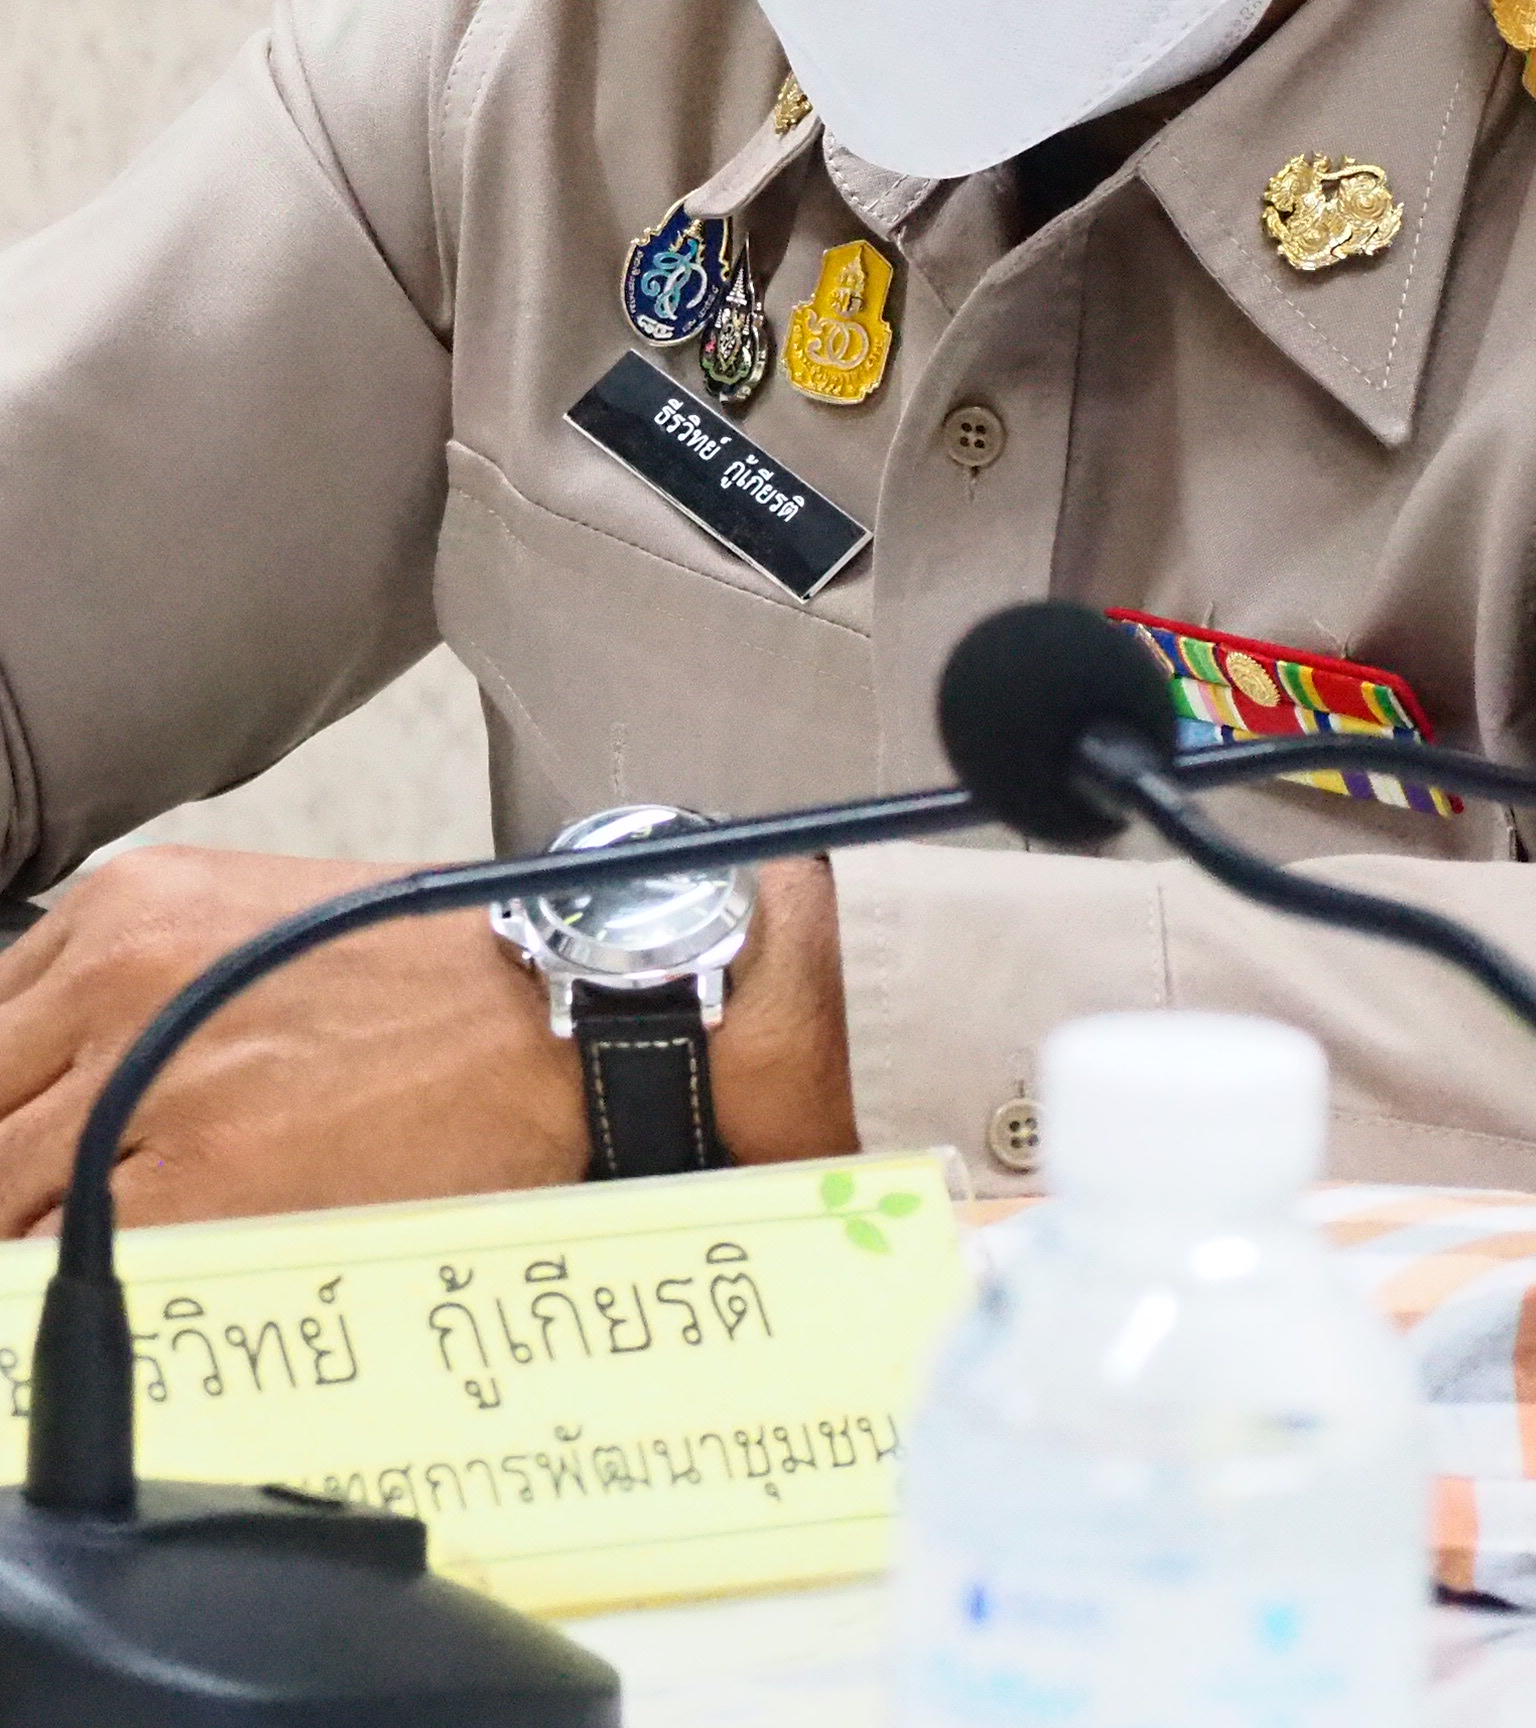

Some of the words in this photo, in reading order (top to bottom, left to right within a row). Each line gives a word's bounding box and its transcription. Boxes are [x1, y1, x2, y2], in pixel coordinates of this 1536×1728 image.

[653, 398, 732, 461] ธีรวิทย์
[720, 454, 805, 523] กู้เกียรติ
[428, 1241, 773, 1409] กู้เกียรติ
